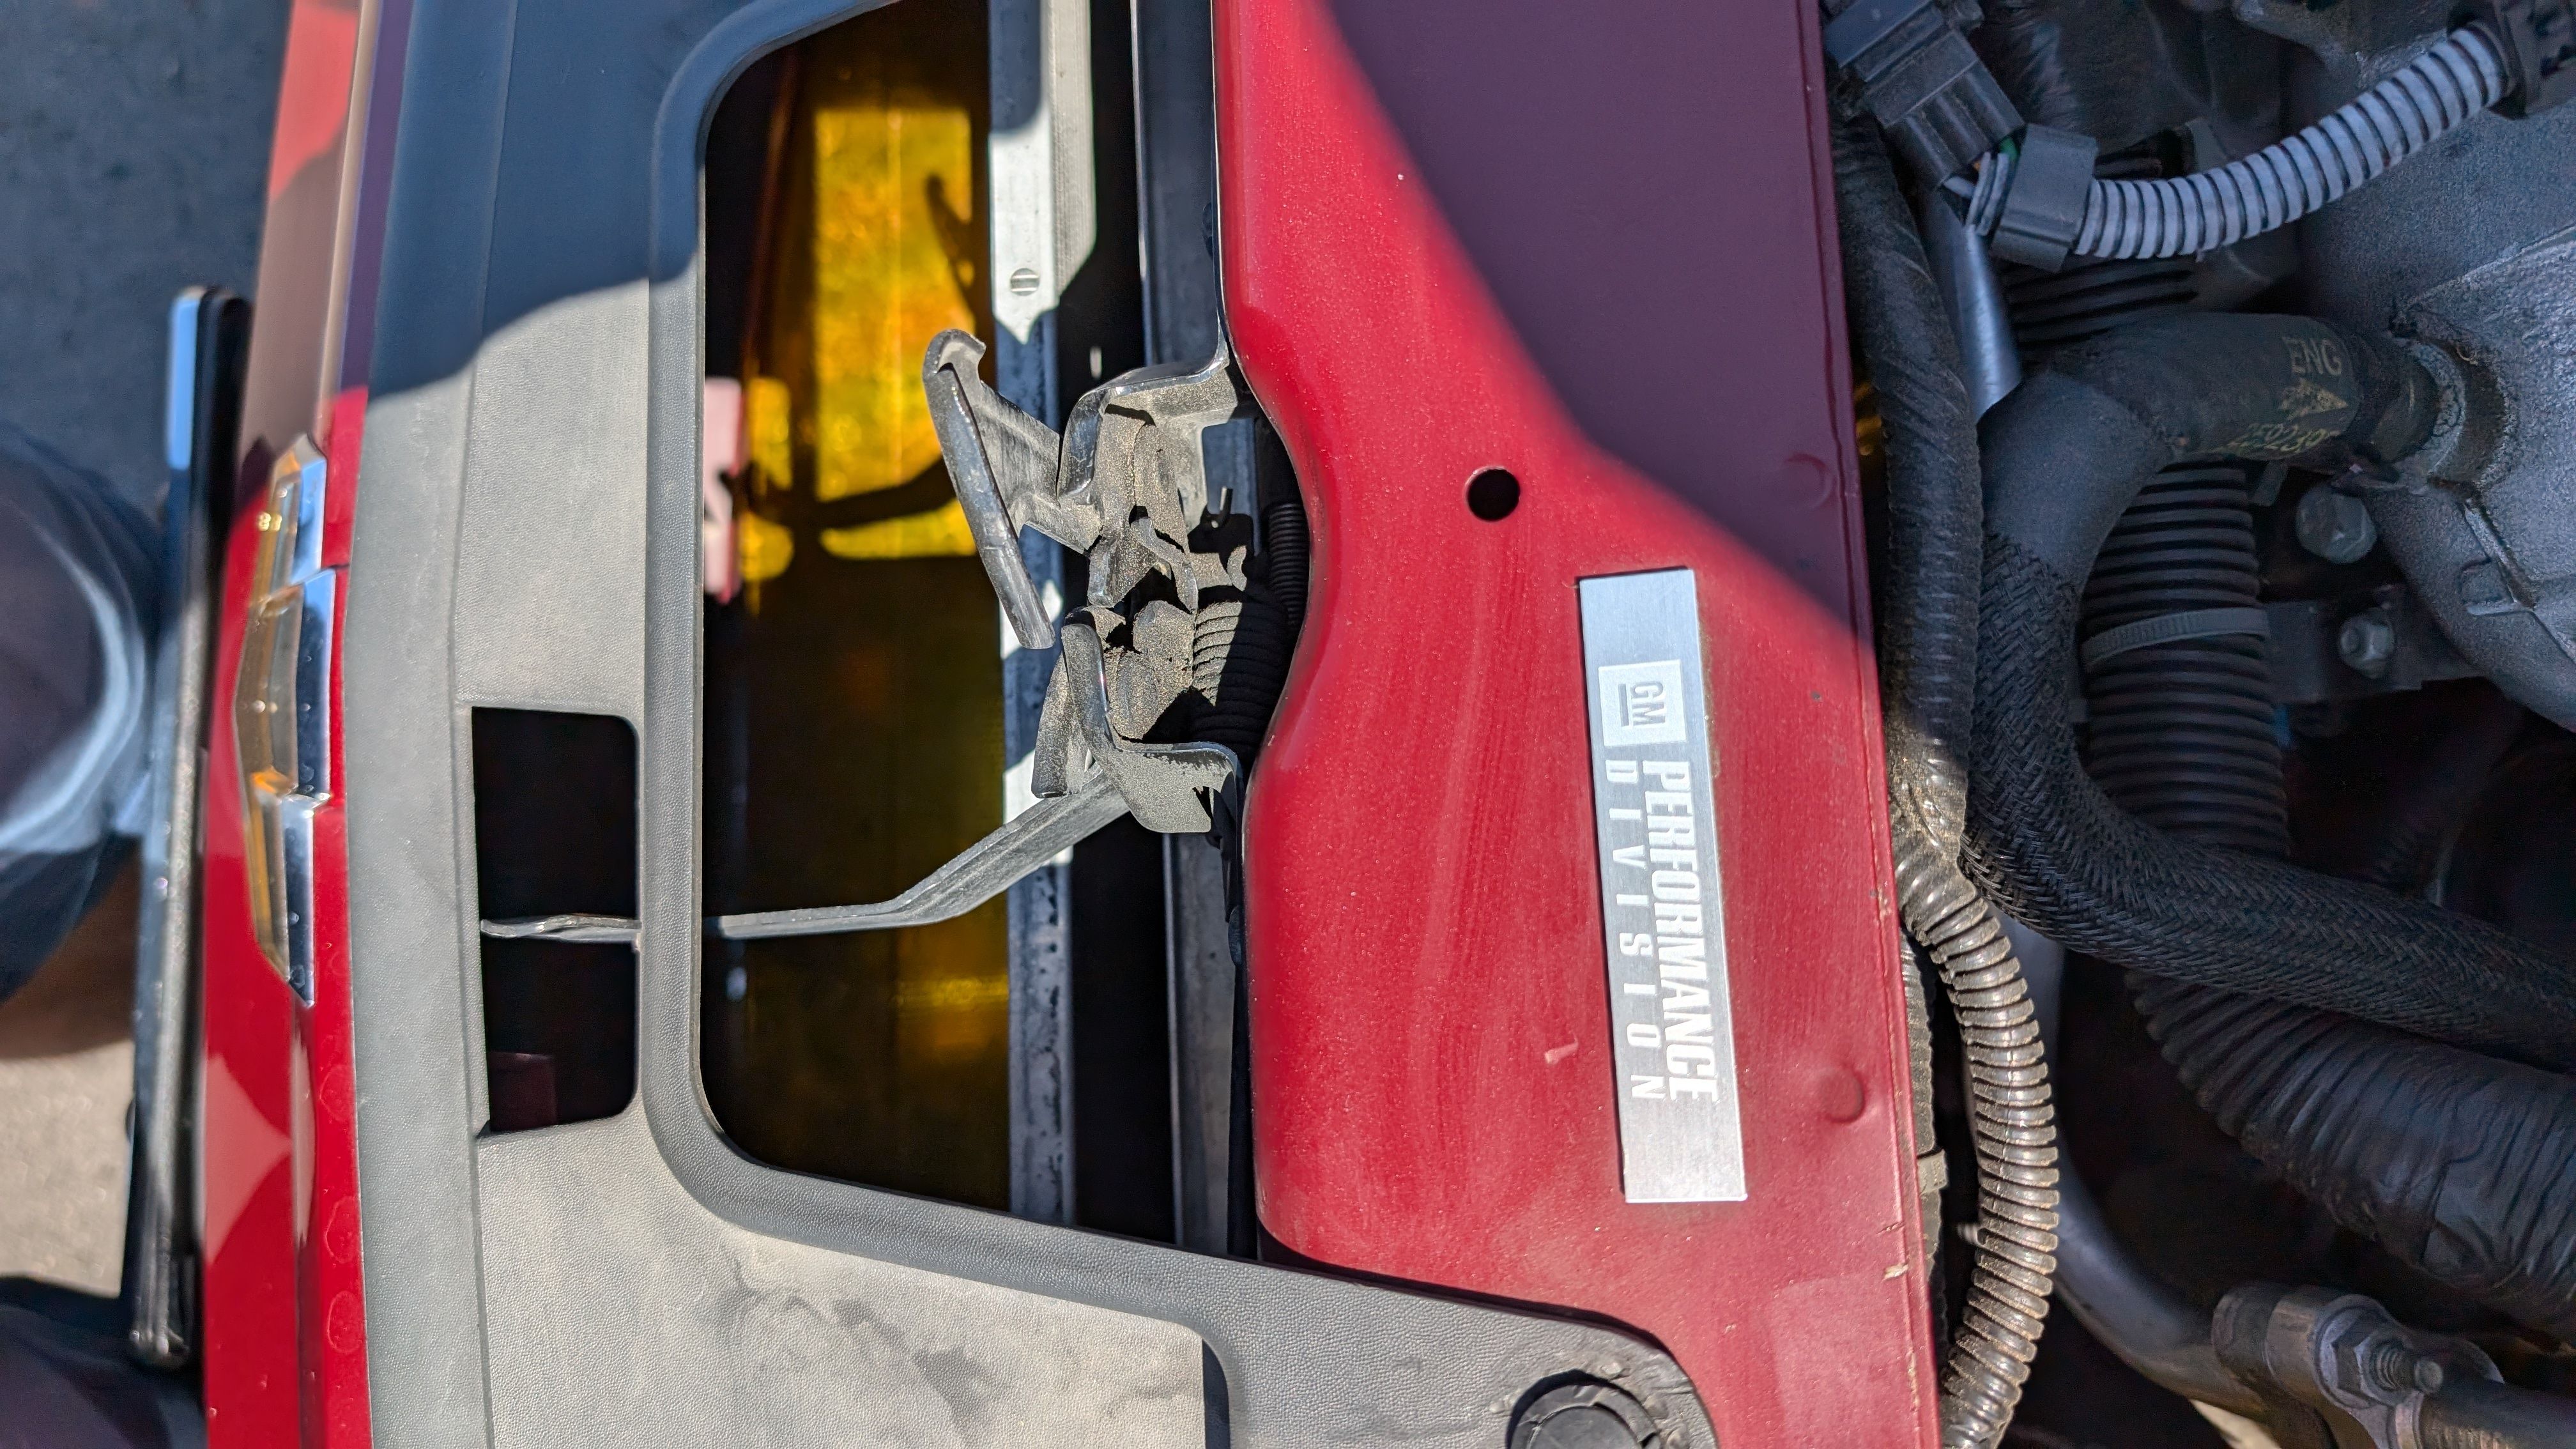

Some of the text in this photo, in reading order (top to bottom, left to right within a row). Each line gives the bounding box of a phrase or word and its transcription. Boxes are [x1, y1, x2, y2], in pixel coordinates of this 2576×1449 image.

[2281, 337, 2342, 376] ENG
[1630, 681, 1666, 726] GM
[1605, 760, 1666, 1100] DIVISION
[1643, 760, 1719, 1103] PERFORMANCE
